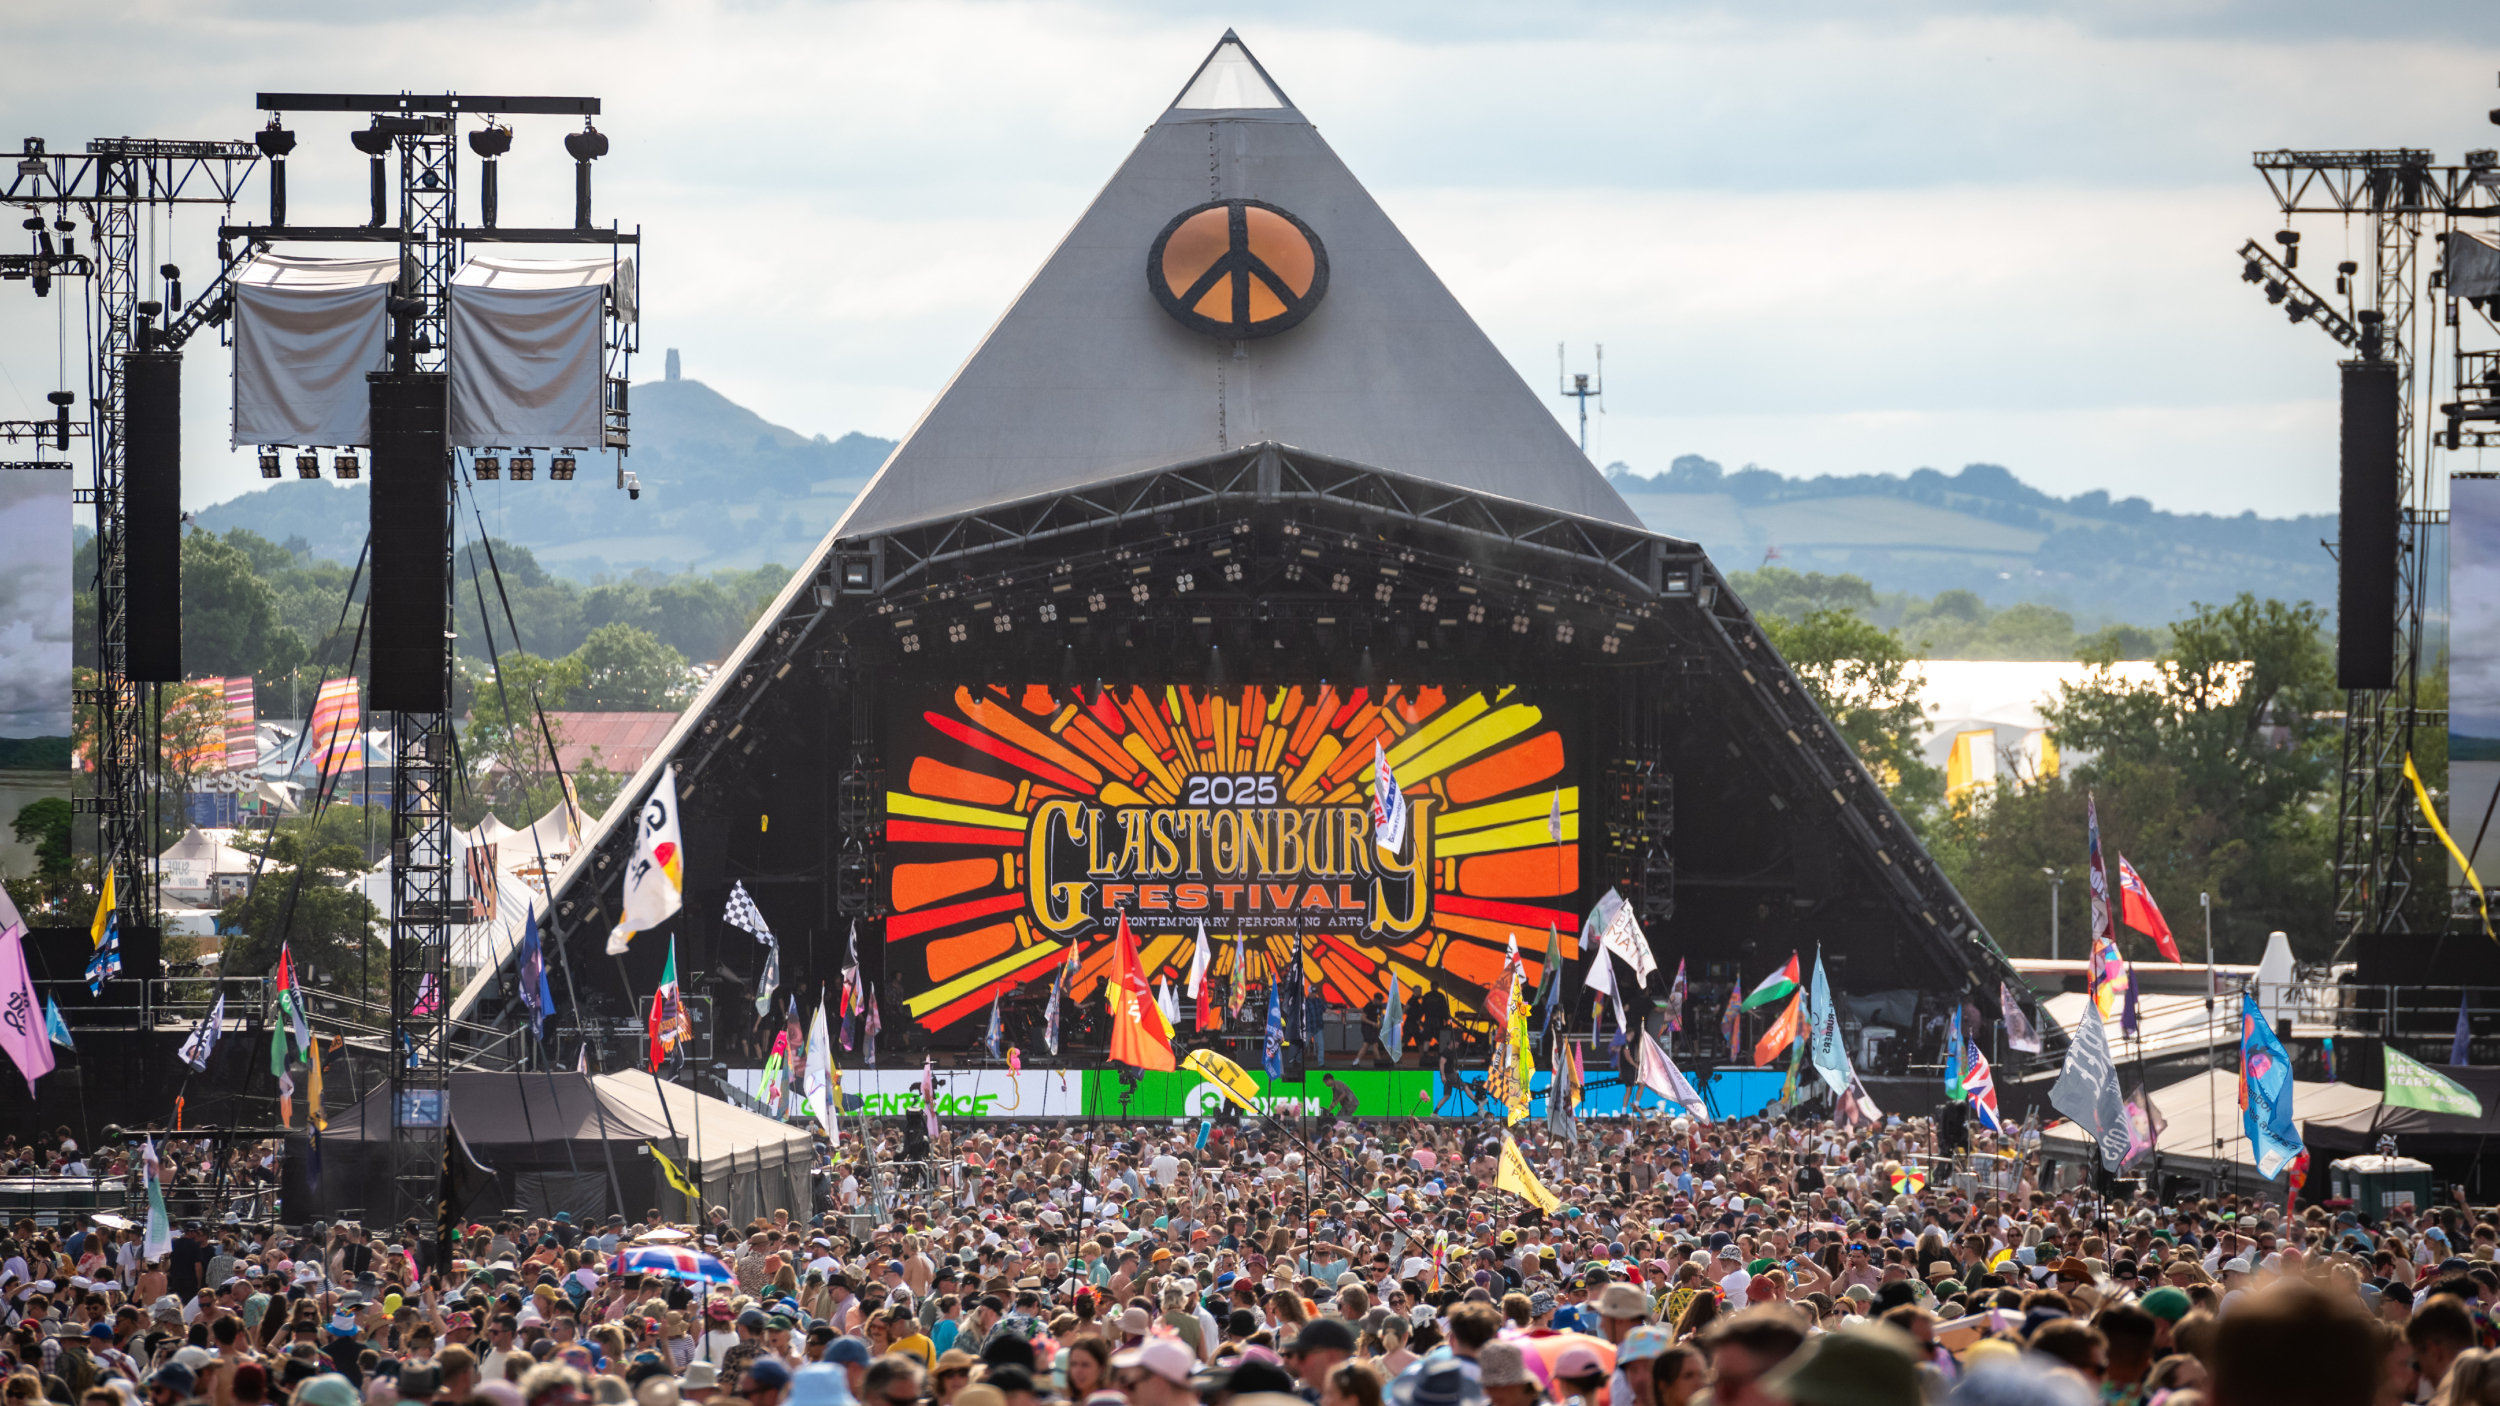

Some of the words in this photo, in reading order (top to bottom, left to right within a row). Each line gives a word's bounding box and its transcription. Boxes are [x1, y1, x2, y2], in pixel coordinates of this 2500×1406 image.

[1188, 776, 1278, 805] 2025
[1029, 799, 1435, 935] GLASTONBURY
[1102, 883, 1367, 911] FESTIVAL
[1103, 916, 1119, 926] OF
[1127, 916, 1230, 927] CONTEMPORARY
[1237, 916, 1321, 927] PERFORMNG
[1328, 916, 1364, 927] ARTS
[2388, 1064, 2414, 1075] ARE
[2388, 1075, 2431, 1087] YEARS
[801, 1093, 998, 1116] GENPACE
[2431, 1092, 2464, 1105] RADIO
[412, 1099, 421, 1118] 2
